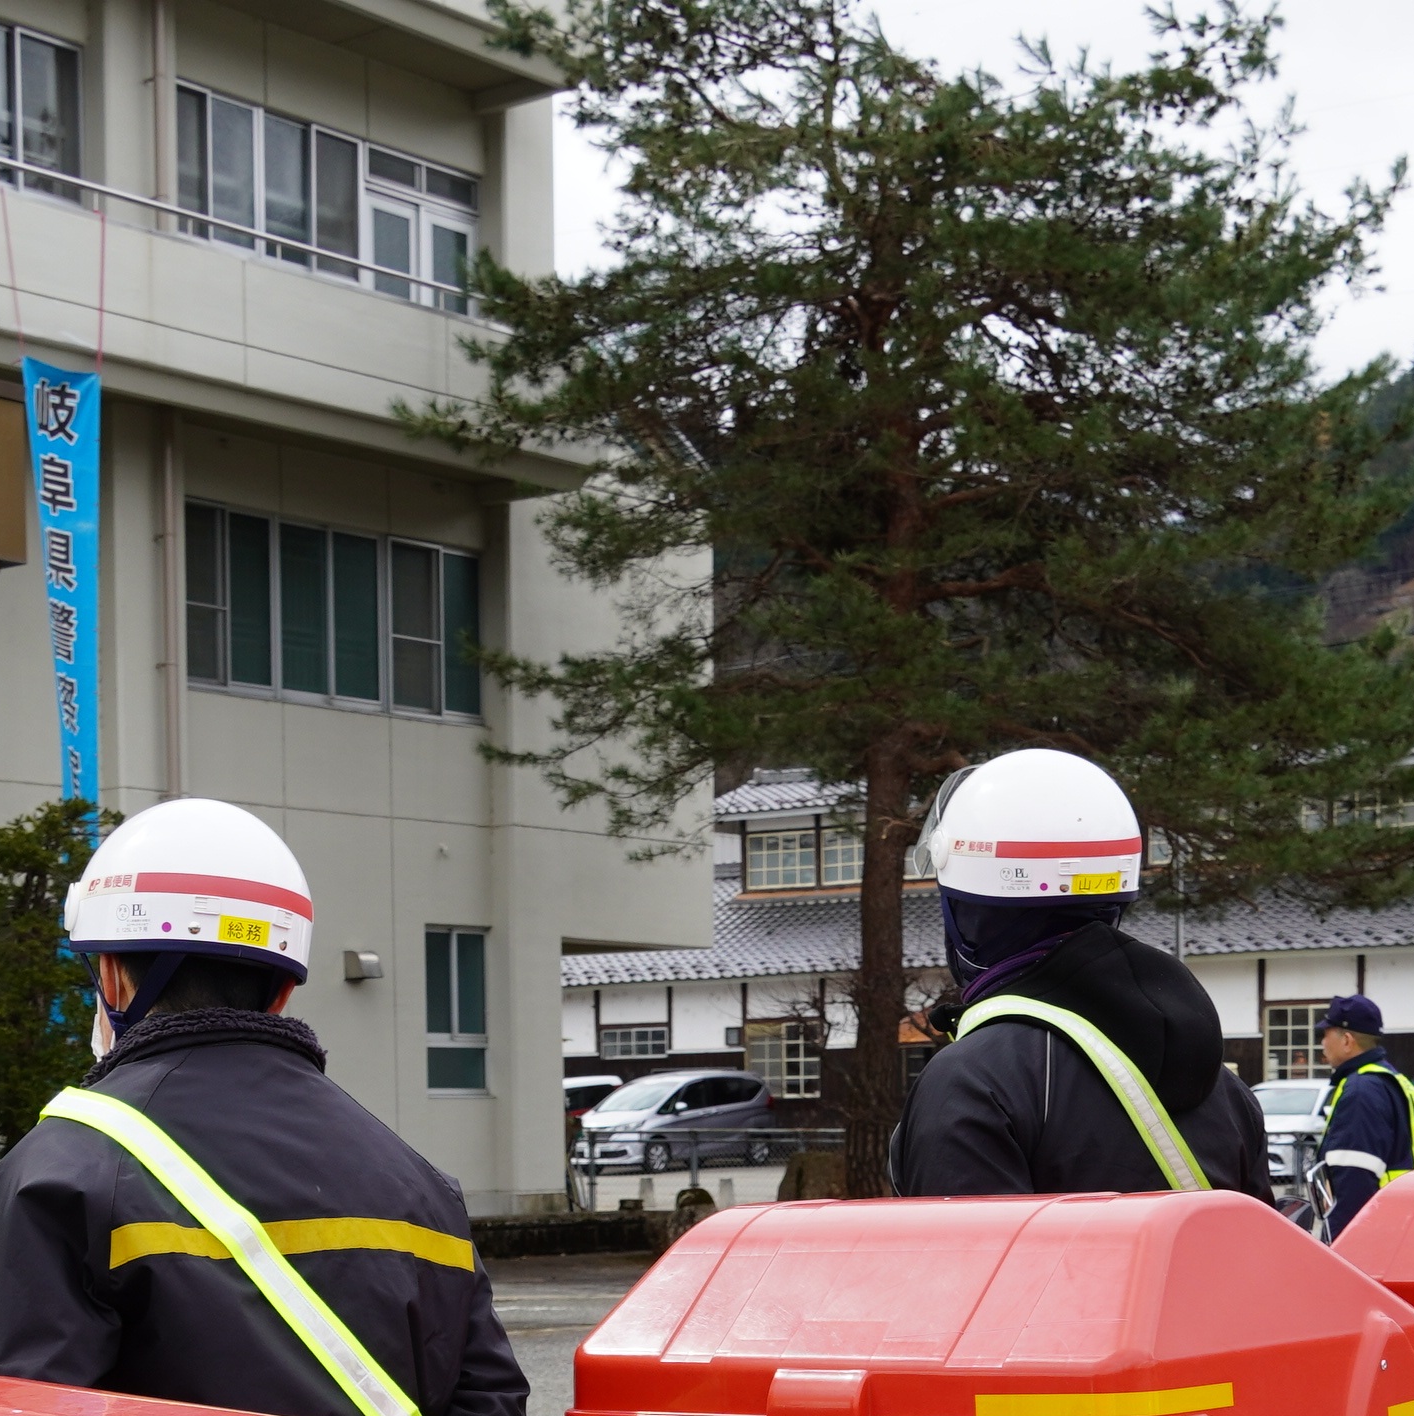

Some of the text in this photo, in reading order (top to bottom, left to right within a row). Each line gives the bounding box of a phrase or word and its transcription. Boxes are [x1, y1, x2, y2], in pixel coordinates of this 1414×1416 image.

[968, 842, 994, 853] 郵便局
[103, 874, 133, 889] 郵便局
[1078, 876, 1117, 891] 山ノ内
[227, 921, 262, 943] 総務
